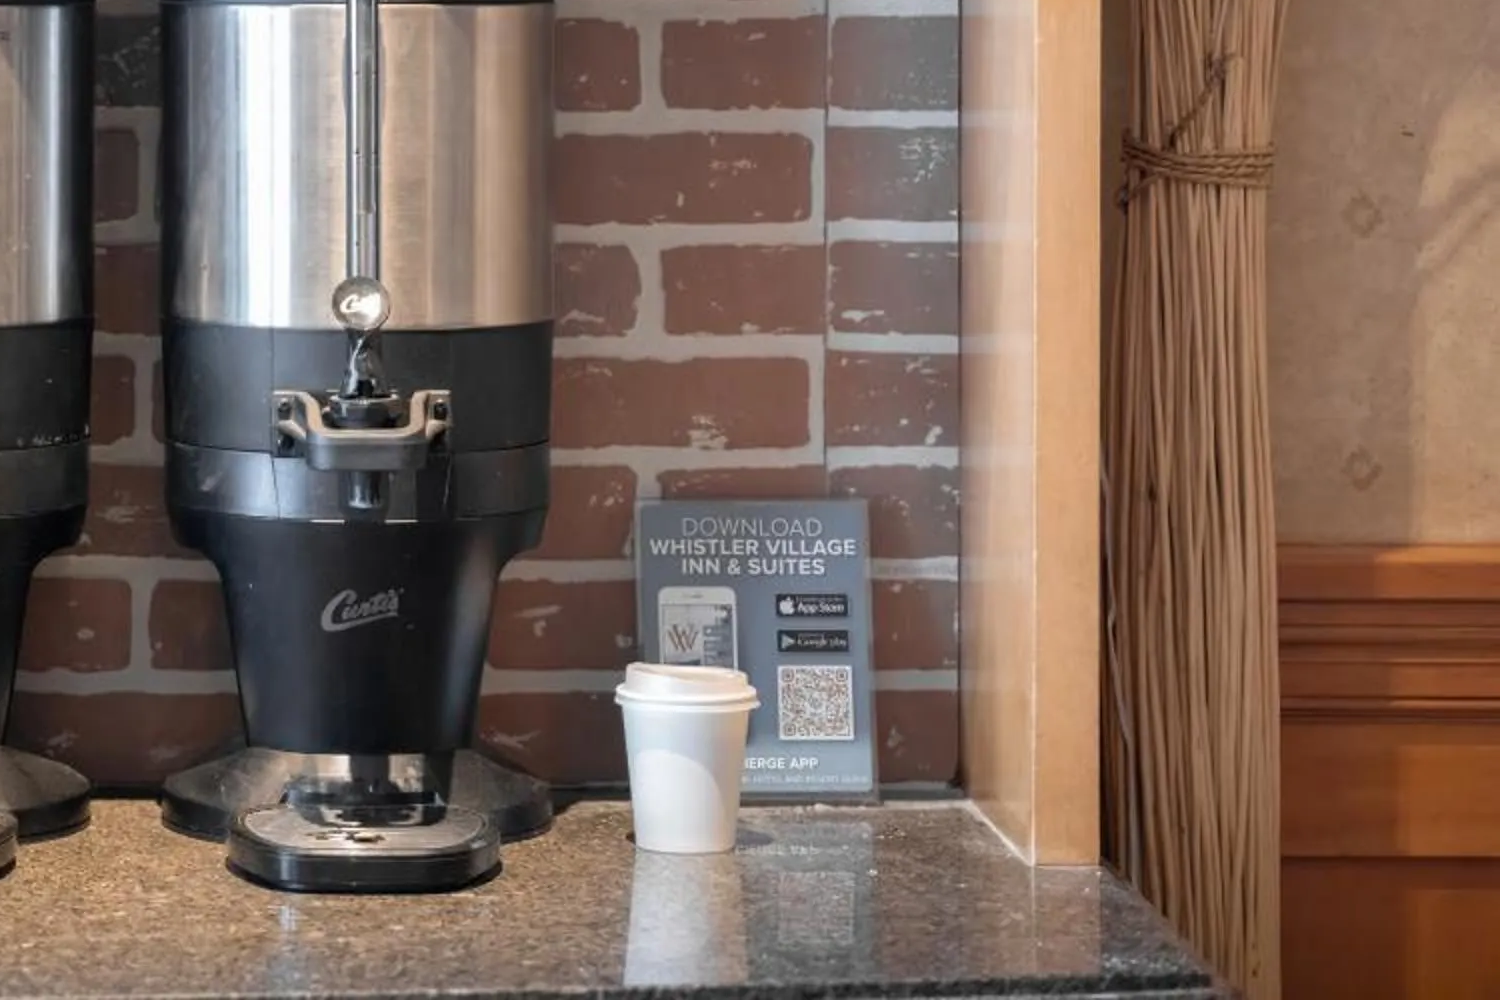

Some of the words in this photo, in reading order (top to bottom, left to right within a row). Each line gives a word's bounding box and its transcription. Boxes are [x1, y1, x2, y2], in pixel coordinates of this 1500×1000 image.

[681, 517, 823, 537] DOWNLOAD
[650, 539, 760, 555] WHISTLER
[765, 539, 857, 555] VILLAGE
[681, 558, 721, 575] INN
[727, 558, 741, 575] &
[747, 558, 826, 575] SUITES
[321, 589, 400, 632] Curtis
[745, 757, 785, 769] IERGE
[789, 757, 819, 769] APP
